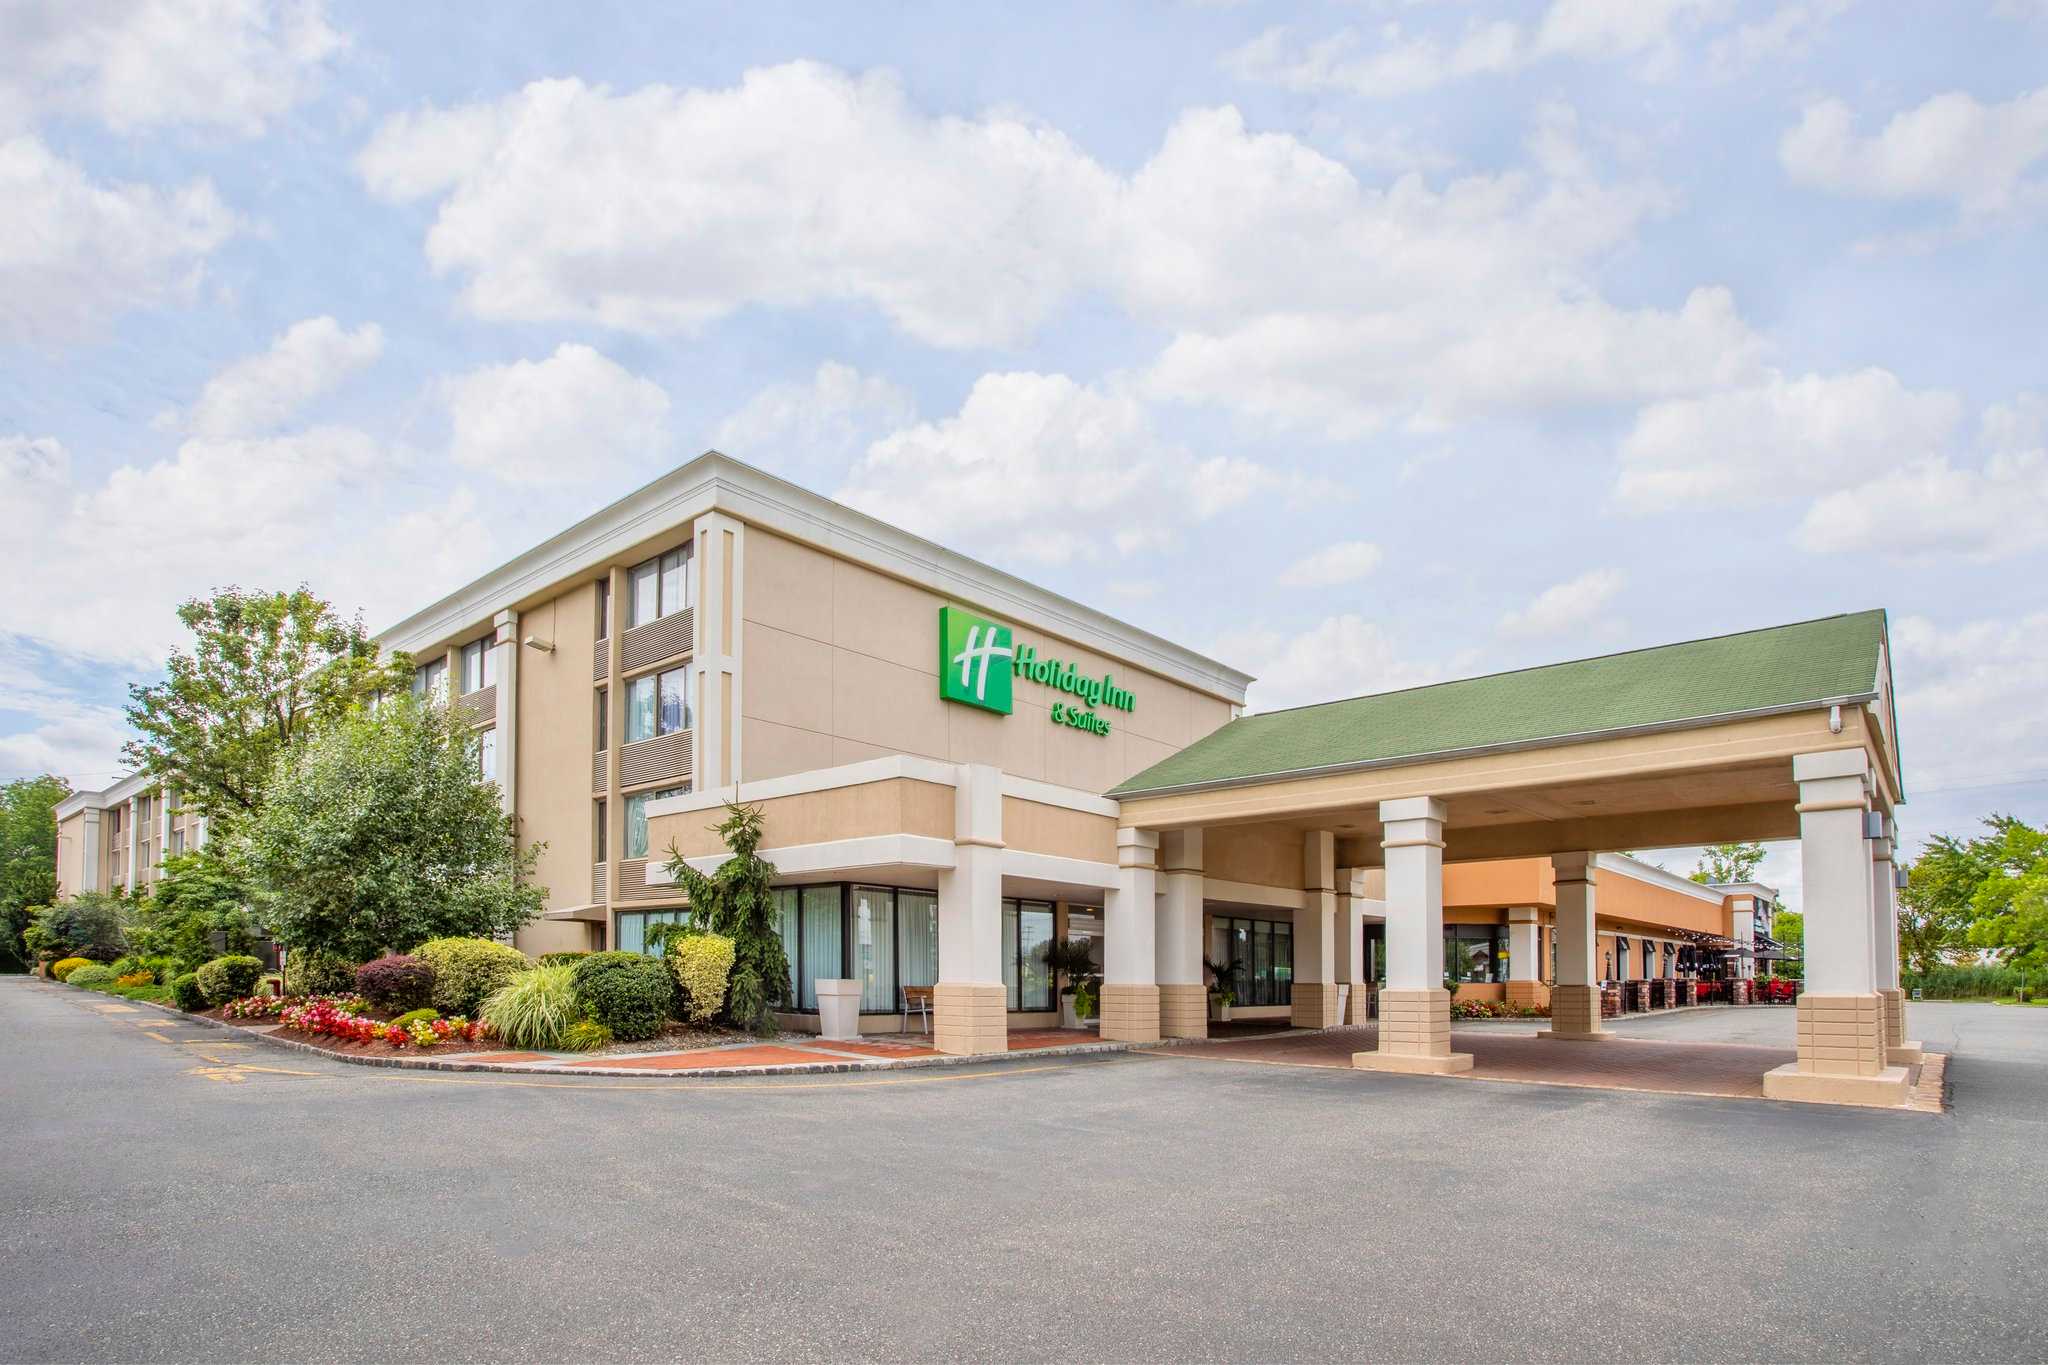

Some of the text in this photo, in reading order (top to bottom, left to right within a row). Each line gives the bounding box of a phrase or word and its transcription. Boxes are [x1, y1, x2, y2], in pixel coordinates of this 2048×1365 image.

[1014, 644, 1136, 712] Holiday Inn
[1051, 702, 1111, 736] & Suites
